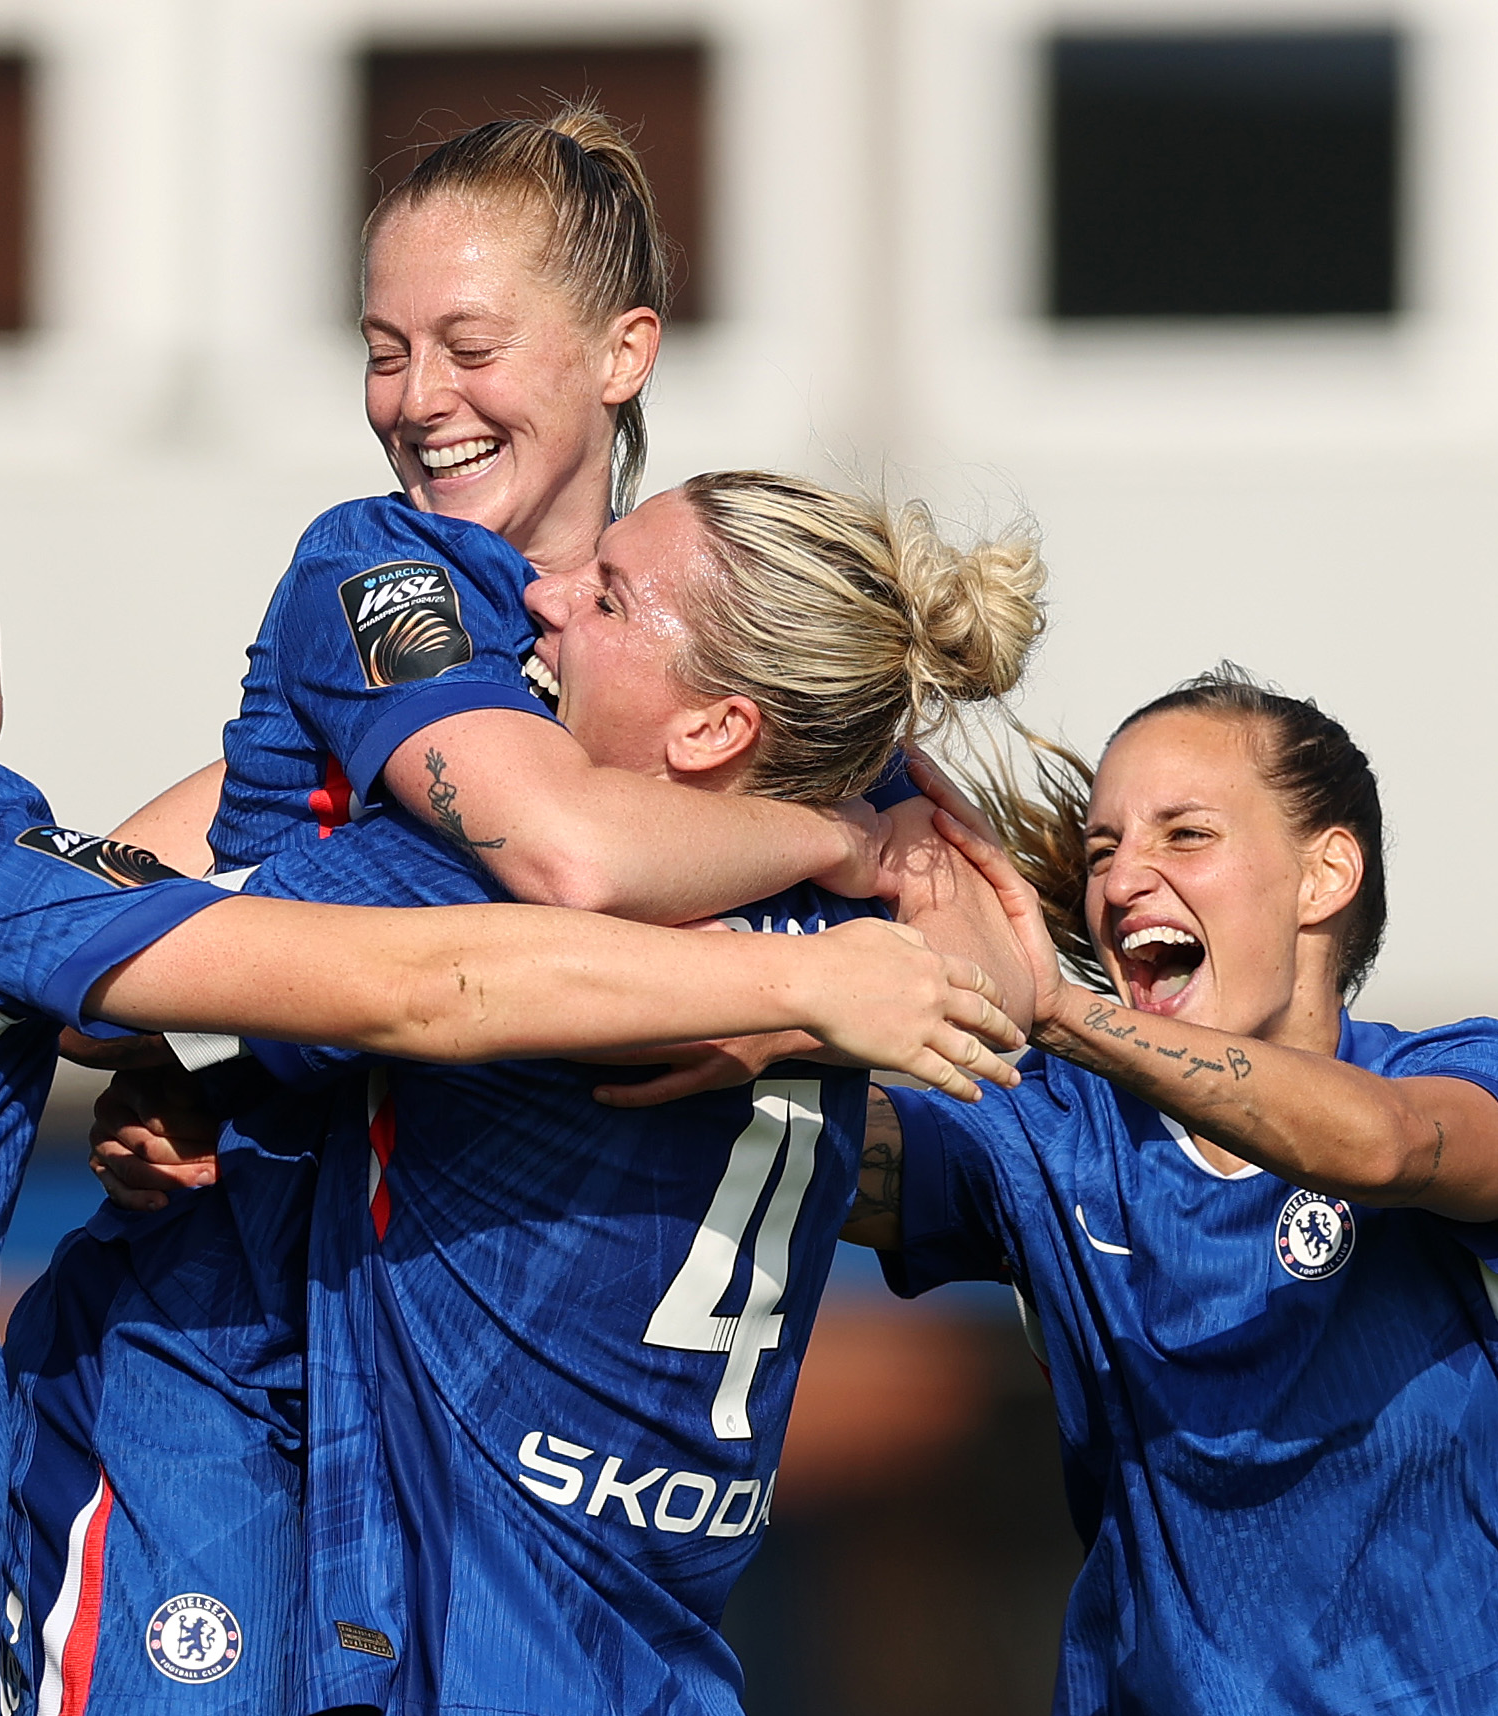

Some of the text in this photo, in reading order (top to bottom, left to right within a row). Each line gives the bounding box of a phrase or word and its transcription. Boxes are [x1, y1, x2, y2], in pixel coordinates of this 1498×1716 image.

[379, 567, 438, 584] BARCLAYS
[356, 575, 446, 623] WSL
[1282, 1191, 1328, 1226] CHELSEA
[641, 1078, 824, 1440] 4
[166, 1597, 227, 1622] CHELSEA
